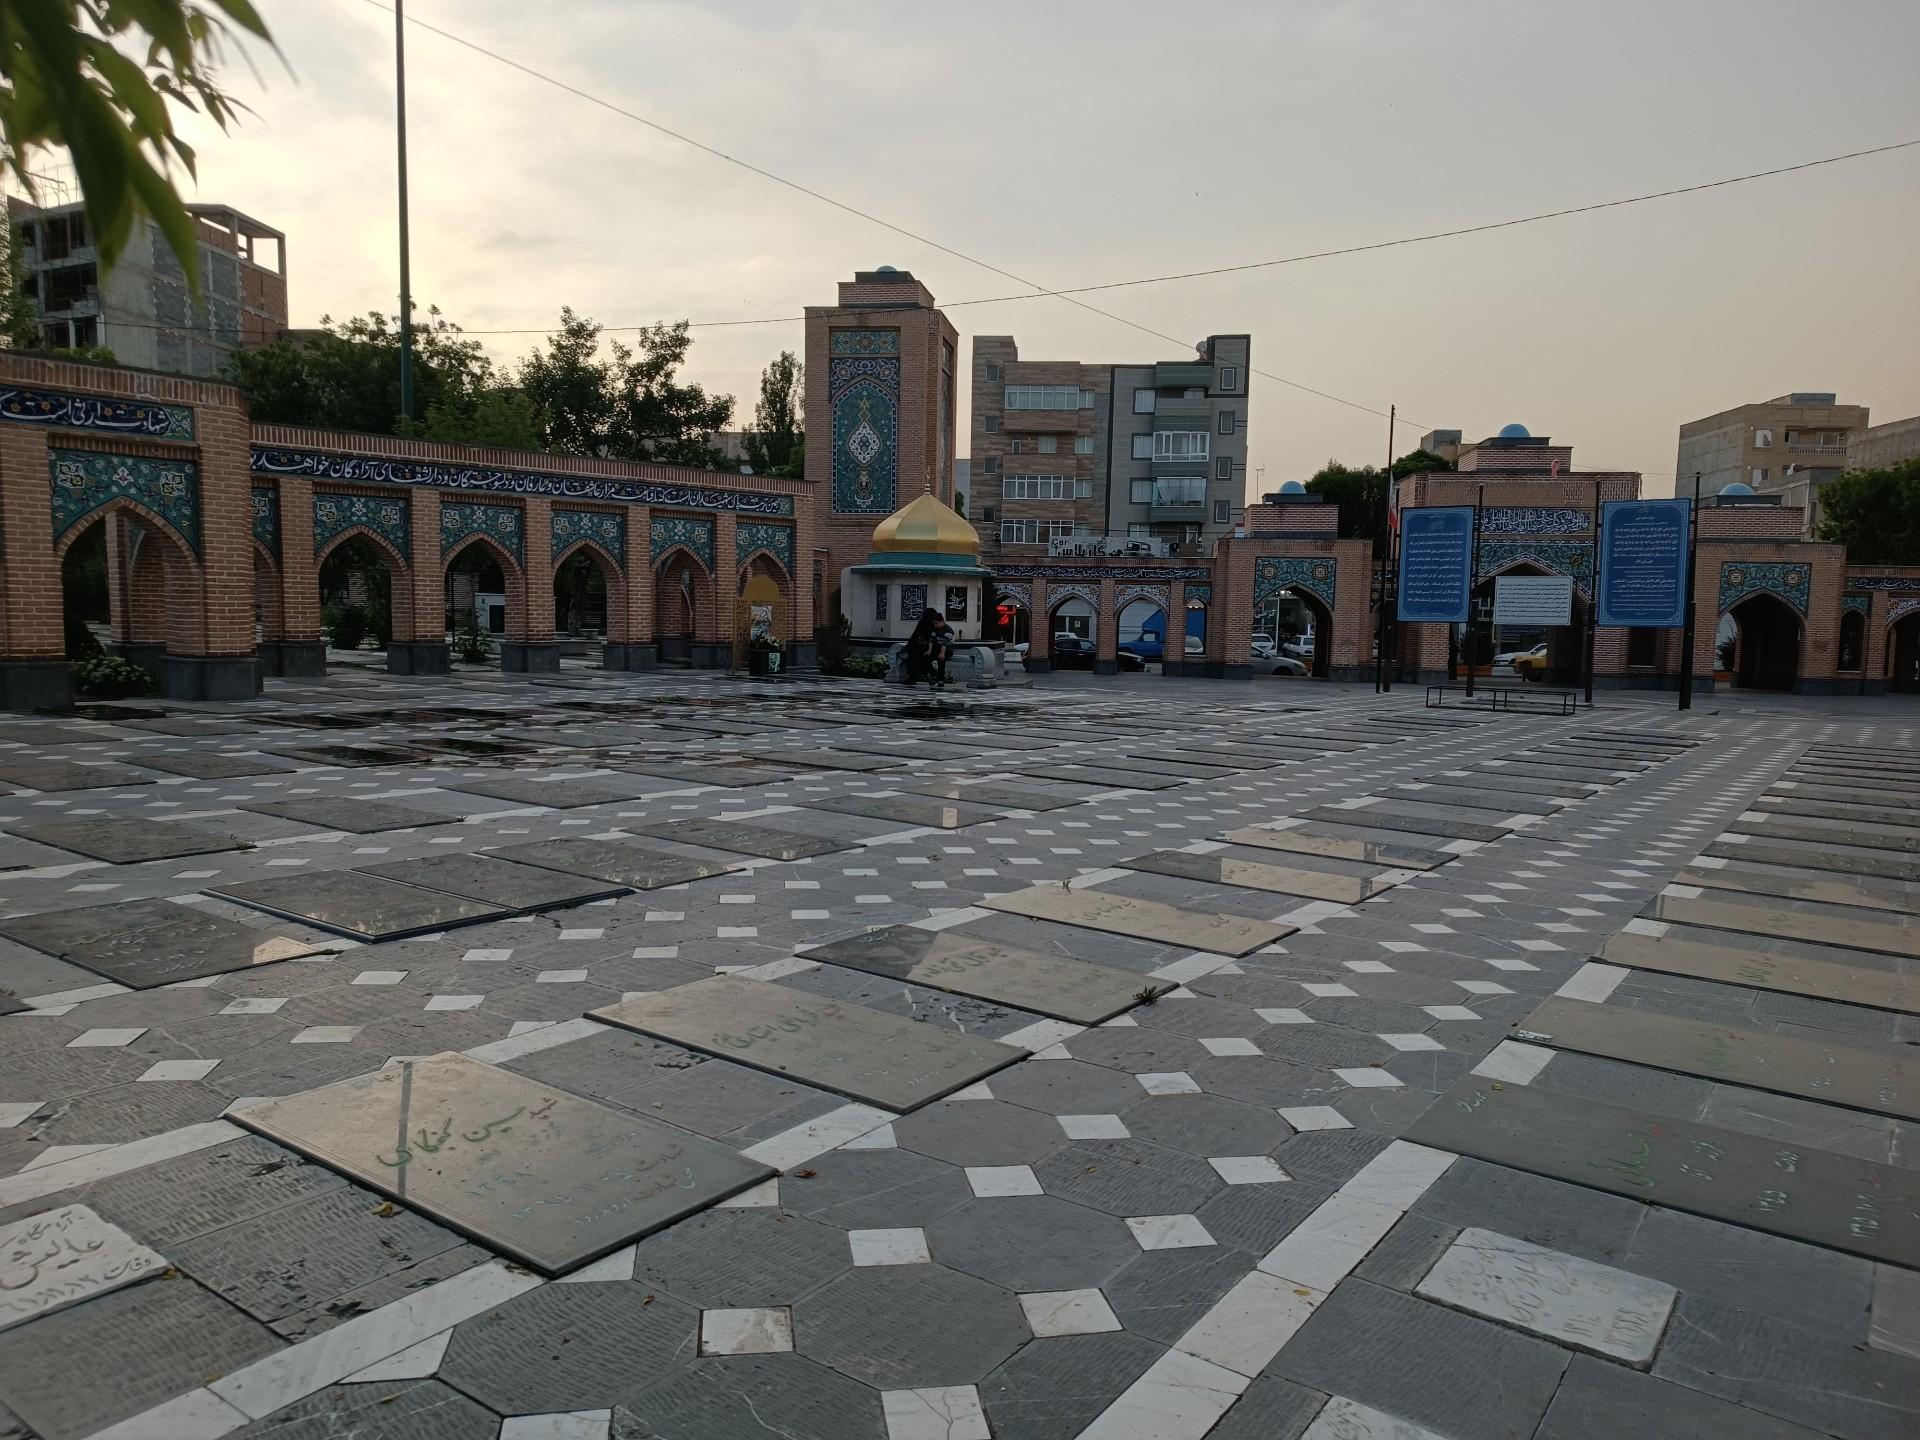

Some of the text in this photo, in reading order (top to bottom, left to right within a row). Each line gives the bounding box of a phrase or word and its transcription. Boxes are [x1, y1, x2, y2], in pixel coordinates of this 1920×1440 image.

[2, 399, 72, 421] است
[71, 398, 101, 426] ارثی
[95, 408, 170, 432] شهادت
[257, 452, 330, 475] خواهد
[330, 459, 380, 480] آزادگان
[449, 470, 509, 489] دلسوختگان
[515, 475, 546, 492] عارفان
[552, 478, 602, 498] عاشقان
